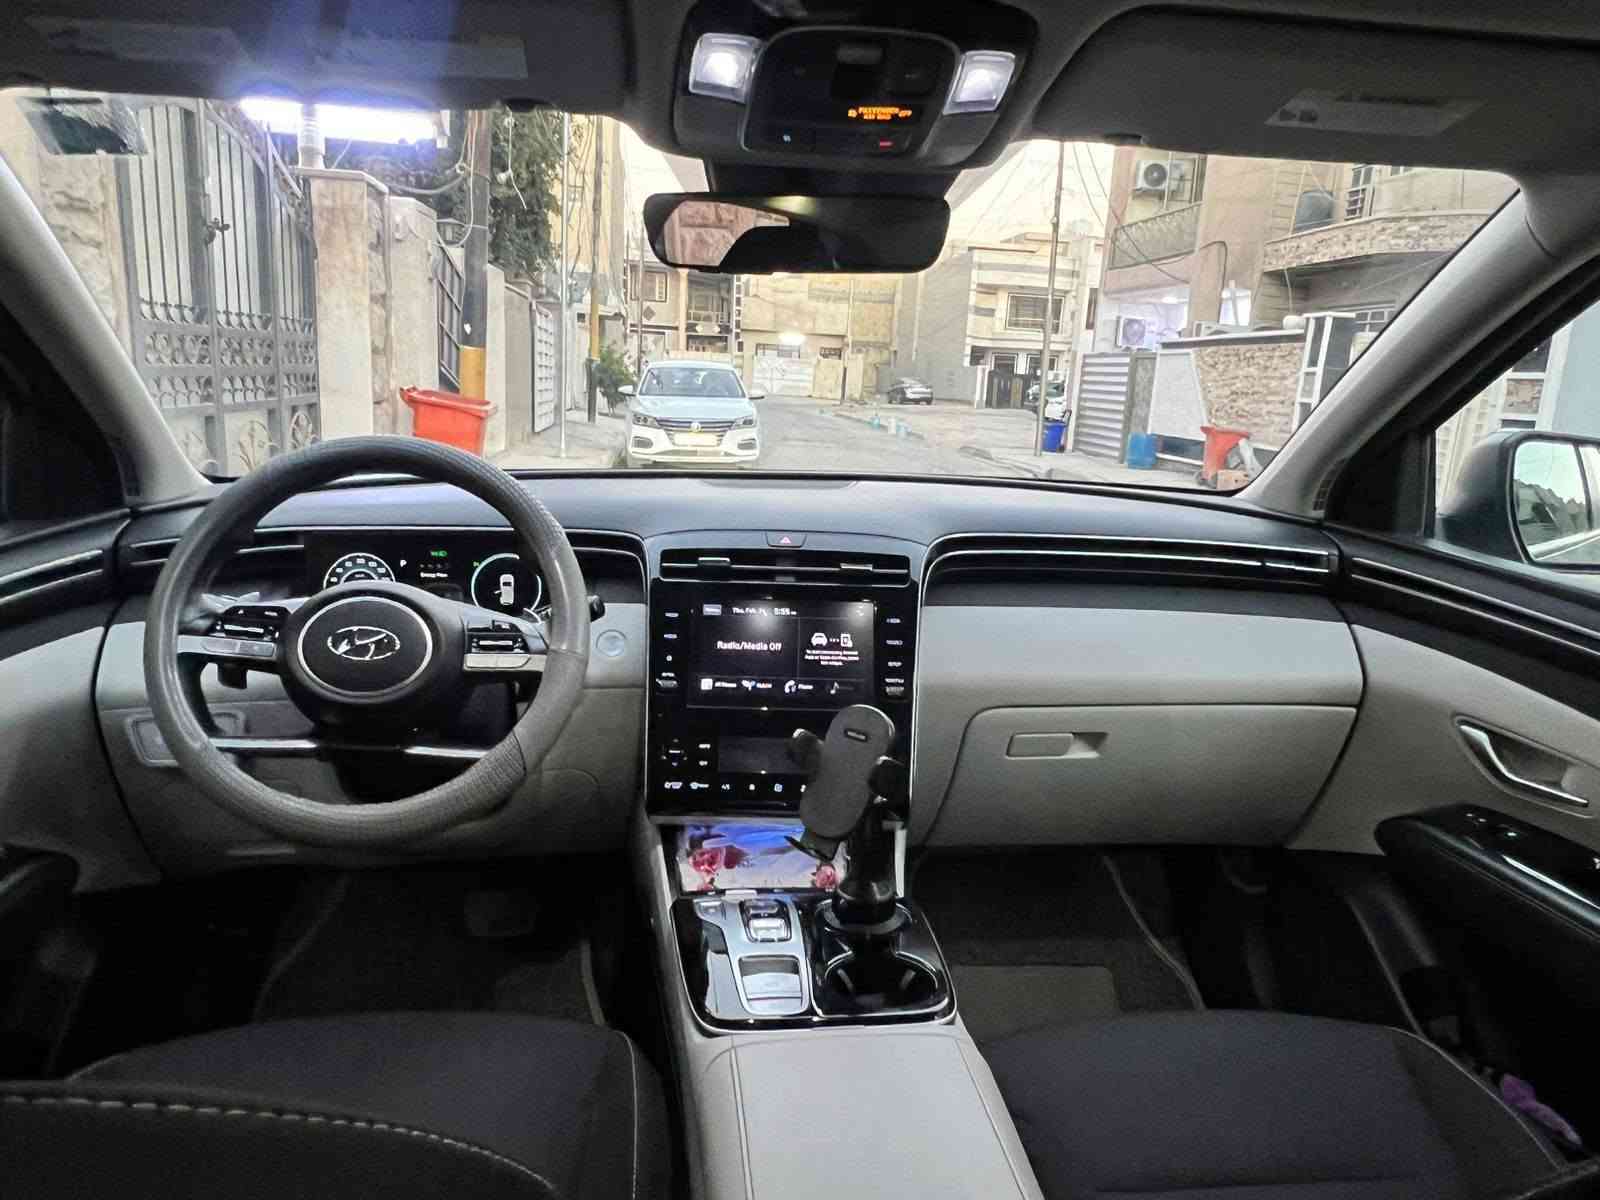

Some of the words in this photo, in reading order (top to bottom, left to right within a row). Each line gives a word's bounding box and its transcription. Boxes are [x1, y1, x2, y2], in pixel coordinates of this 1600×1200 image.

[399, 559, 408, 568] P
[717, 641, 768, 651] Radio/Media
[769, 642, 783, 652] Off
